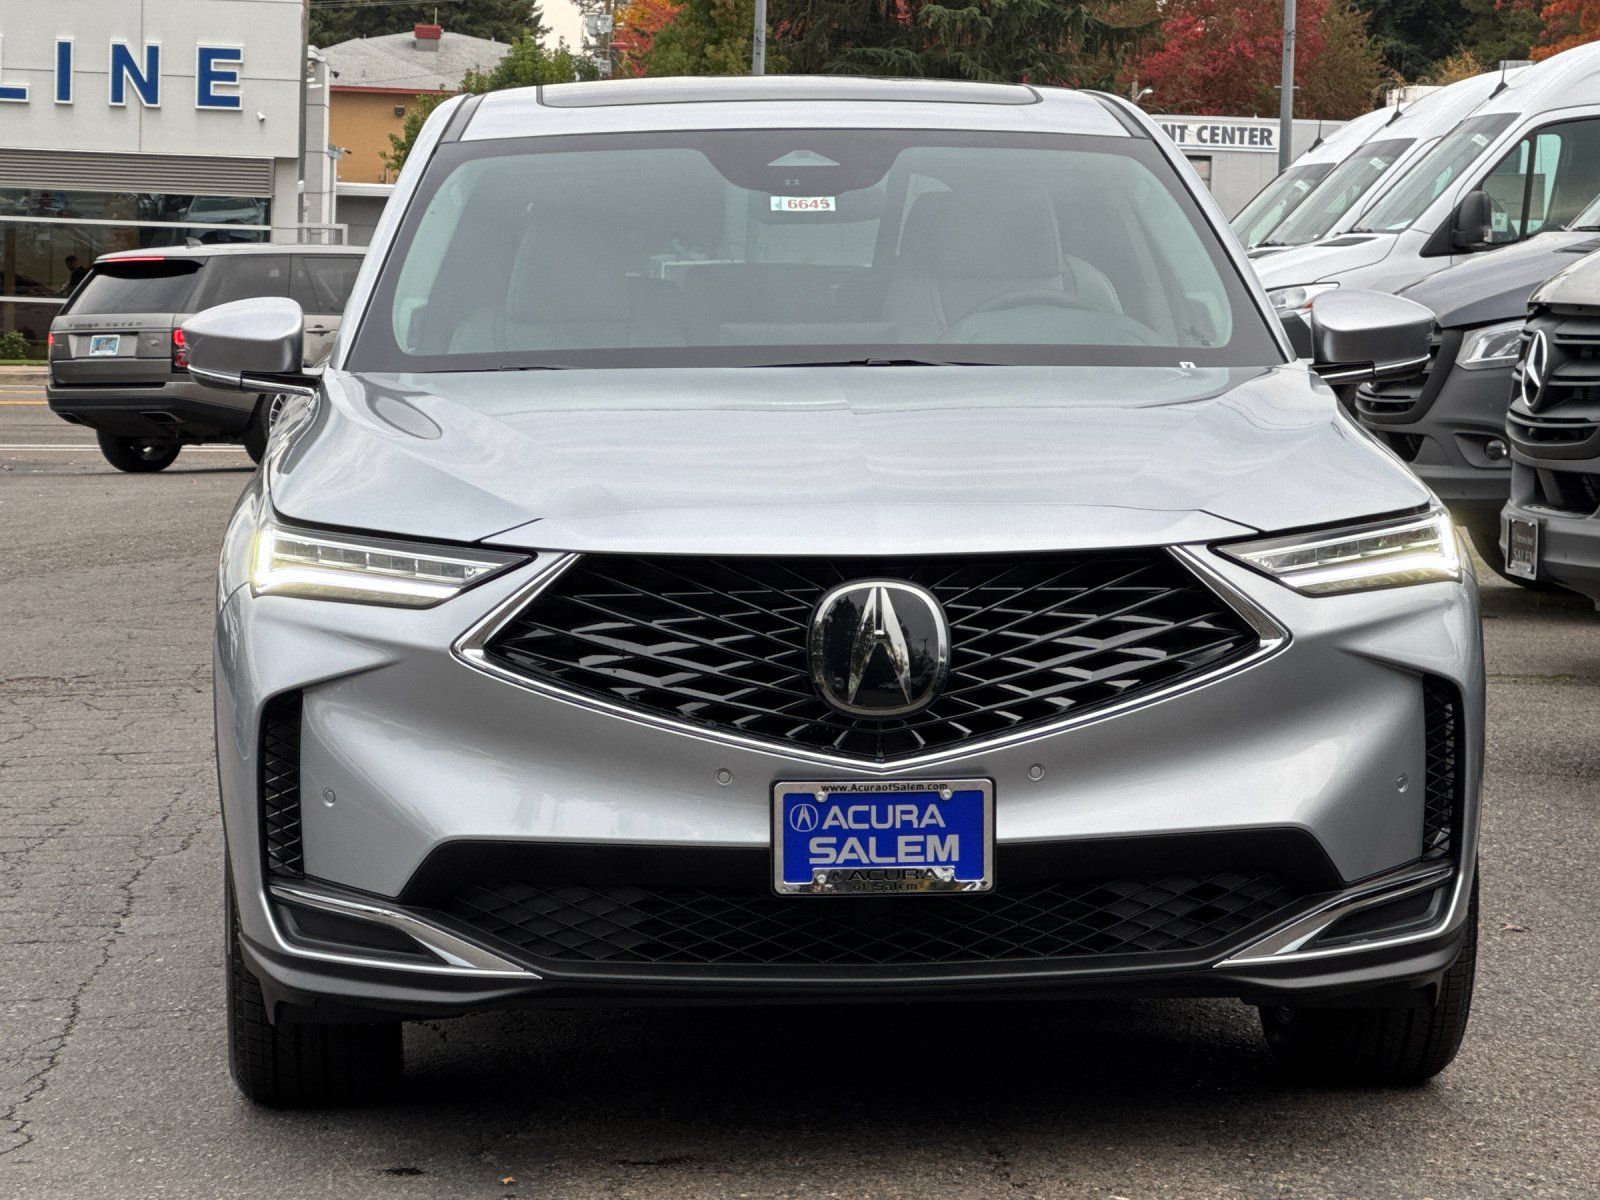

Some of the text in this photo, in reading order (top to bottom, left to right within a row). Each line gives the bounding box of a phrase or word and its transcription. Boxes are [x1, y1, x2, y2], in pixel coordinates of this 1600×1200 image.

[1196, 125, 1273, 146] CENTER
[787, 199, 831, 209] 6645
[821, 783, 948, 792] www.AcuraofSalem.com
[822, 803, 946, 830] ACURA
[809, 834, 960, 865] SALEM
[848, 868, 941, 881] ACURA
[852, 881, 918, 892] of Salem
